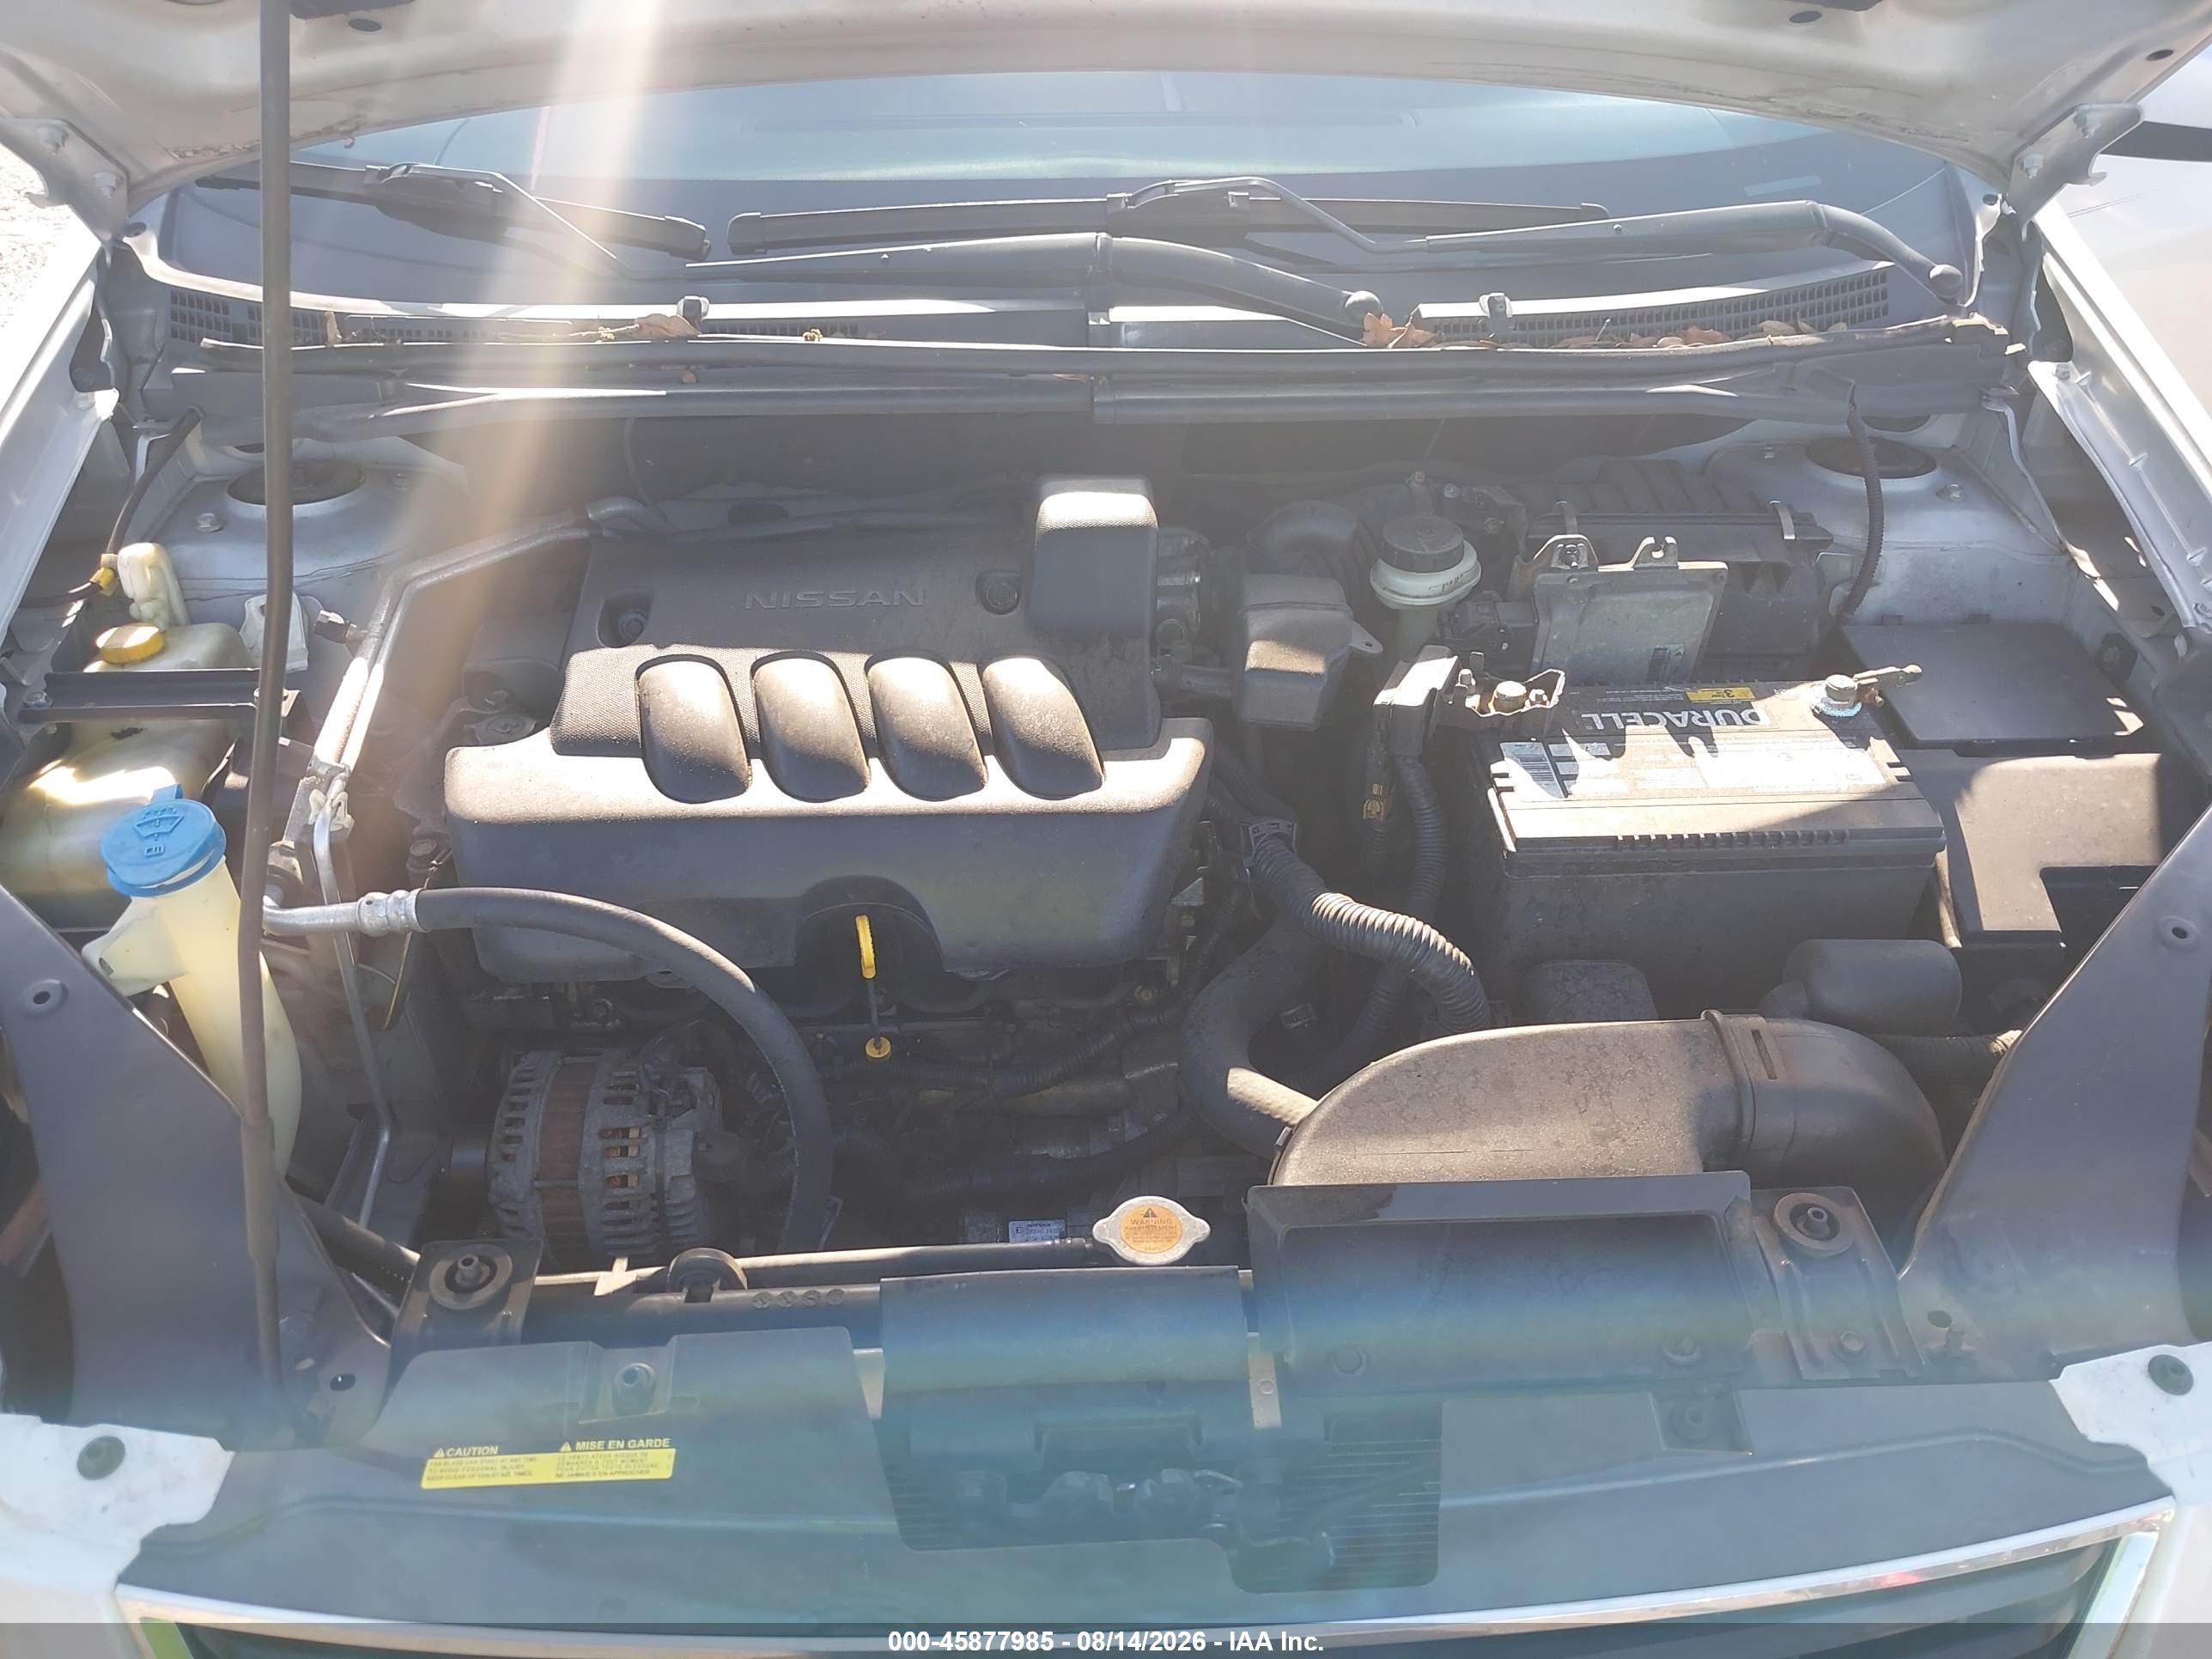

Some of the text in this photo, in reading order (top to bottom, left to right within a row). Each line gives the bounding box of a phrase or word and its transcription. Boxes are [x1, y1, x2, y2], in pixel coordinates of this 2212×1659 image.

[743, 590, 928, 610] NISSAN
[1581, 708, 1771, 730] DURACELL
[447, 1445, 499, 1457] CAUTION
[575, 1437, 672, 1450] MISE EN GARDE
